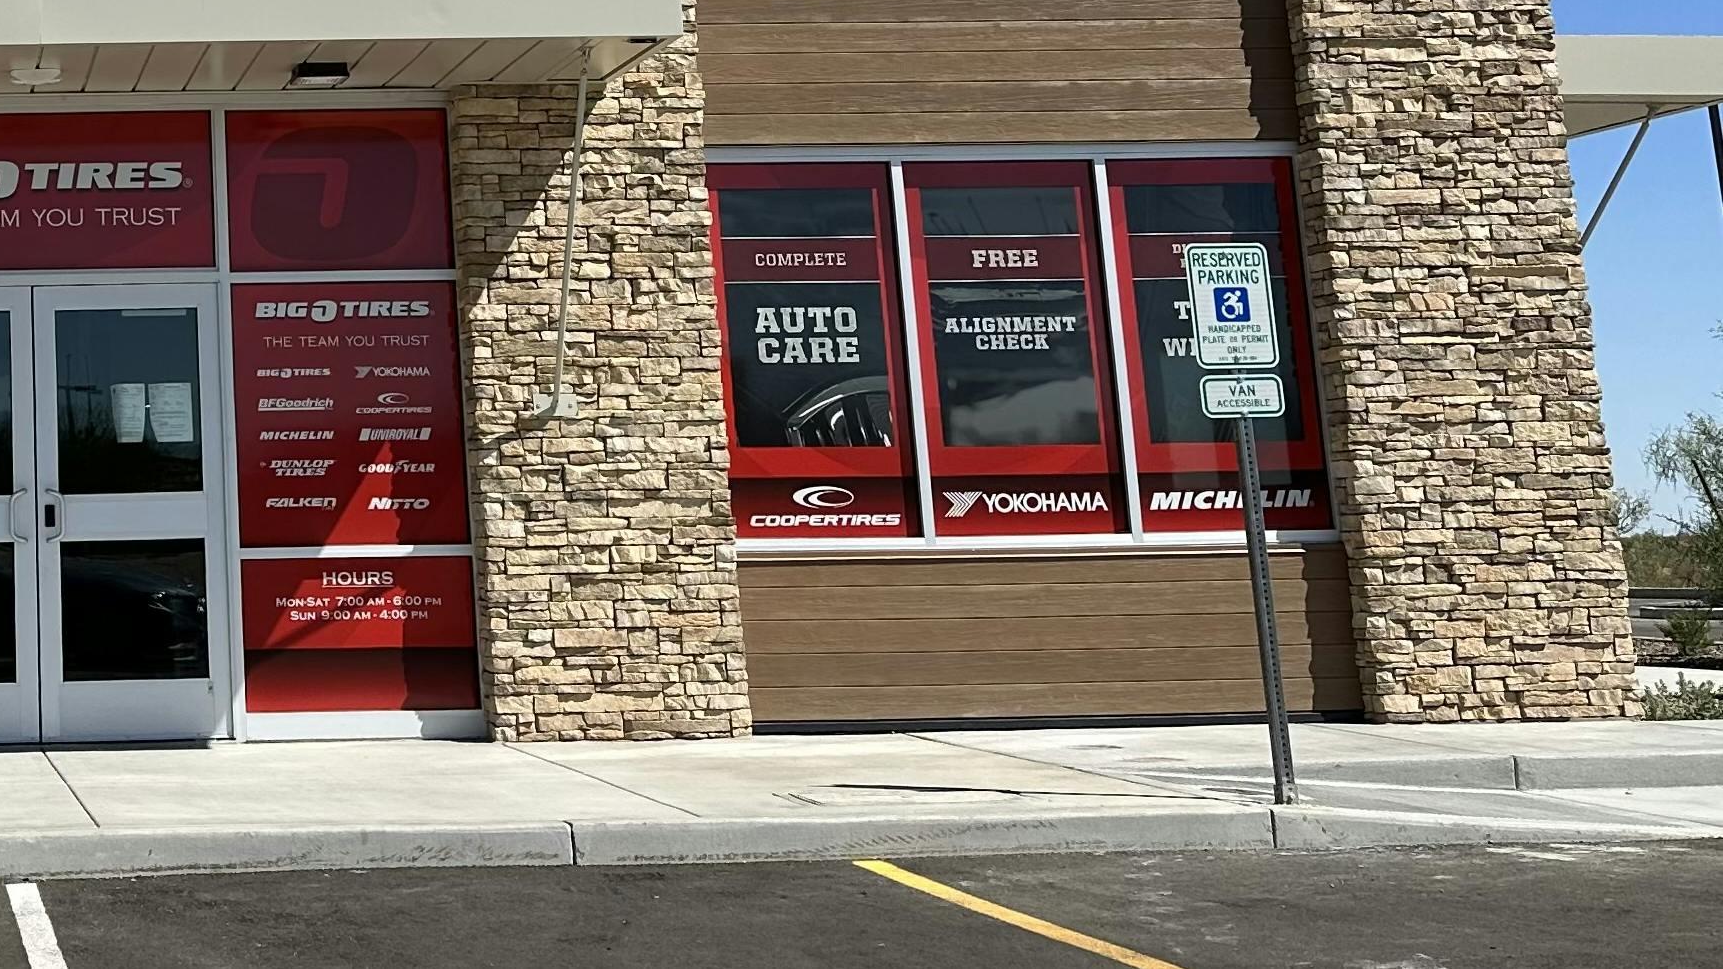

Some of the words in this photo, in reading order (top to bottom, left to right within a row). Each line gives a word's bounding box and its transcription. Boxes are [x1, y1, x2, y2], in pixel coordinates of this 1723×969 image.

[24, 162, 183, 190] TIRES
[32, 208, 84, 226] YOU
[94, 207, 182, 226] TRUST
[755, 252, 847, 266] COMPLETE
[972, 250, 1038, 268] FREE
[1192, 252, 1261, 268] RESERVED
[1198, 269, 1259, 285] PARKING
[255, 302, 308, 318] BIG
[311, 300, 338, 322] O
[339, 301, 430, 317] TIRES
[755, 307, 857, 334] AUTO
[945, 316, 1076, 333] ALIGNMENT
[263, 336, 293, 348] THE
[299, 336, 339, 347] TEAM
[345, 335, 375, 347] YOU
[380, 335, 430, 347] TRUST
[976, 334, 1050, 350] CHECK
[757, 337, 860, 364] CARE
[256, 369, 279, 377] BIG
[292, 368, 331, 377] TIRES
[373, 366, 430, 377] YOKOHAMA
[1228, 385, 1256, 397] VAN
[258, 397, 334, 409] BFGoodrich
[1217, 399, 1271, 407] ACCESSIBLE
[260, 431, 334, 441] MICHELIN
[370, 428, 421, 441] UNIROYAL
[269, 459, 335, 469] DUNLOP
[276, 468, 326, 477] TIRES
[368, 498, 430, 510] NITTO
[982, 492, 1108, 513] YOKOHAMA
[1149, 489, 1311, 511] MICHLIN
[750, 514, 901, 527] COOPERTIRES
[322, 571, 394, 586] HOURS
[335, 596, 364, 606] 7:00
[366, 597, 385, 606] AM
[393, 596, 422, 606] 6:00
[425, 597, 442, 606] PM
[290, 611, 316, 621] SUN
[321, 610, 350, 620] 9:00
[353, 611, 371, 620] AM
[379, 610, 408, 620] 4:00
[411, 611, 428, 620] PM
